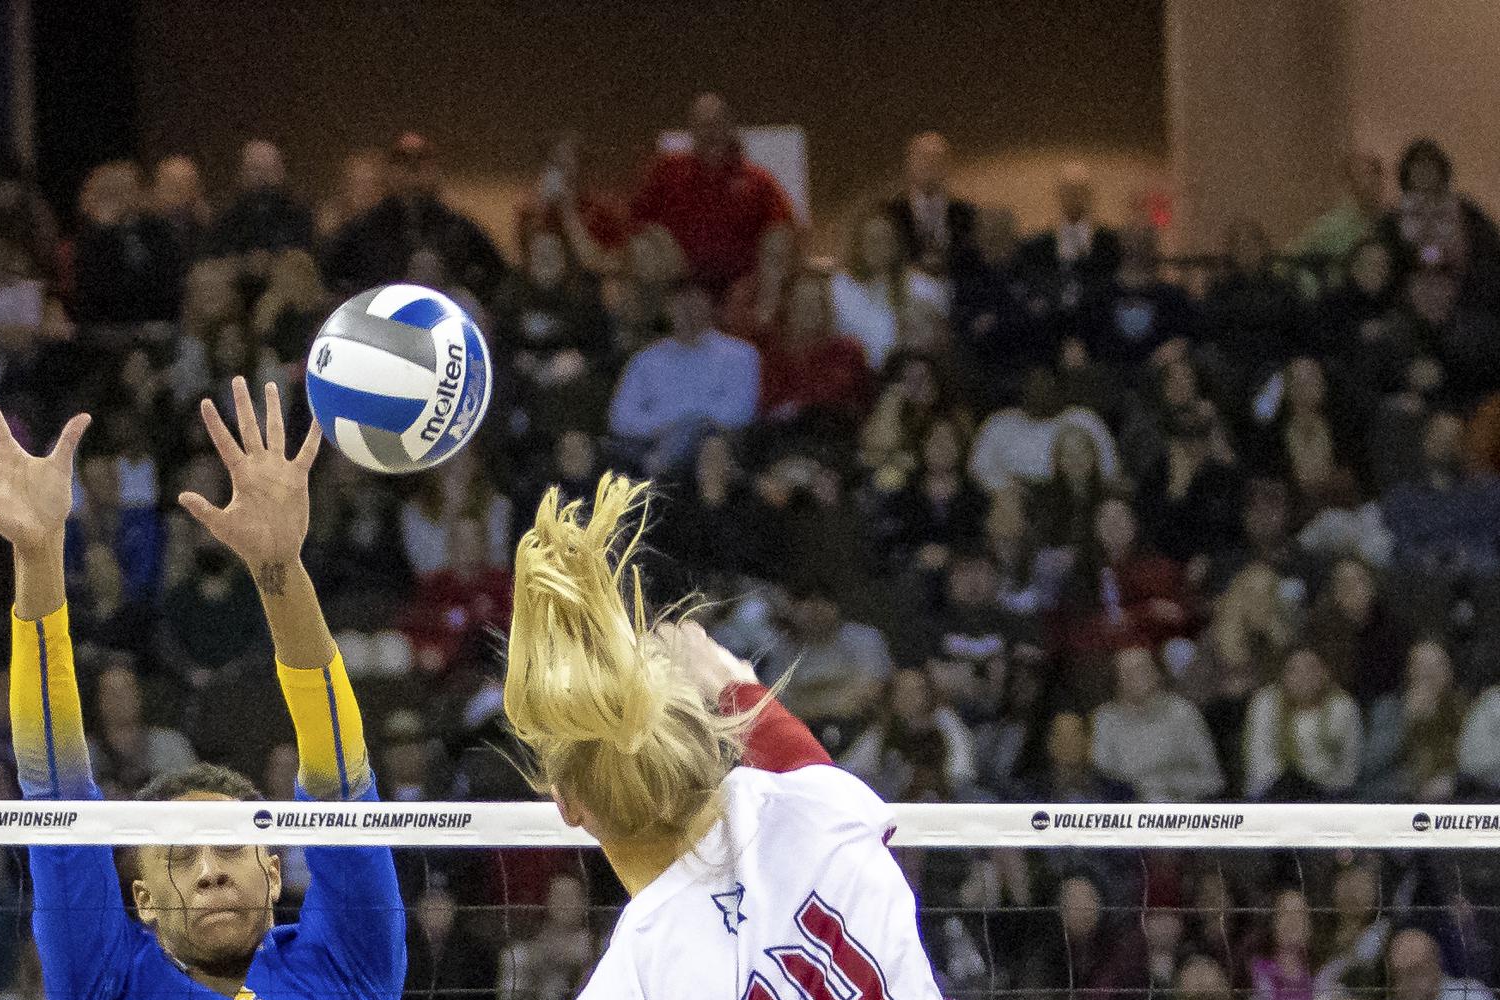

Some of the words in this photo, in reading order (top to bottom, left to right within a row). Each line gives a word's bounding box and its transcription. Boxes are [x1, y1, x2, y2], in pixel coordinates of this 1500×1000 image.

[421, 344, 463, 442] molten
[277, 813, 357, 828] VOLLEYBALL
[362, 813, 472, 828] CHAMPIONSHIP
[1054, 814, 1132, 828] VOLLEYBALL
[1138, 814, 1244, 829] CHAMPIONSHIP
[1435, 815, 1500, 829] VOLLEYBA
